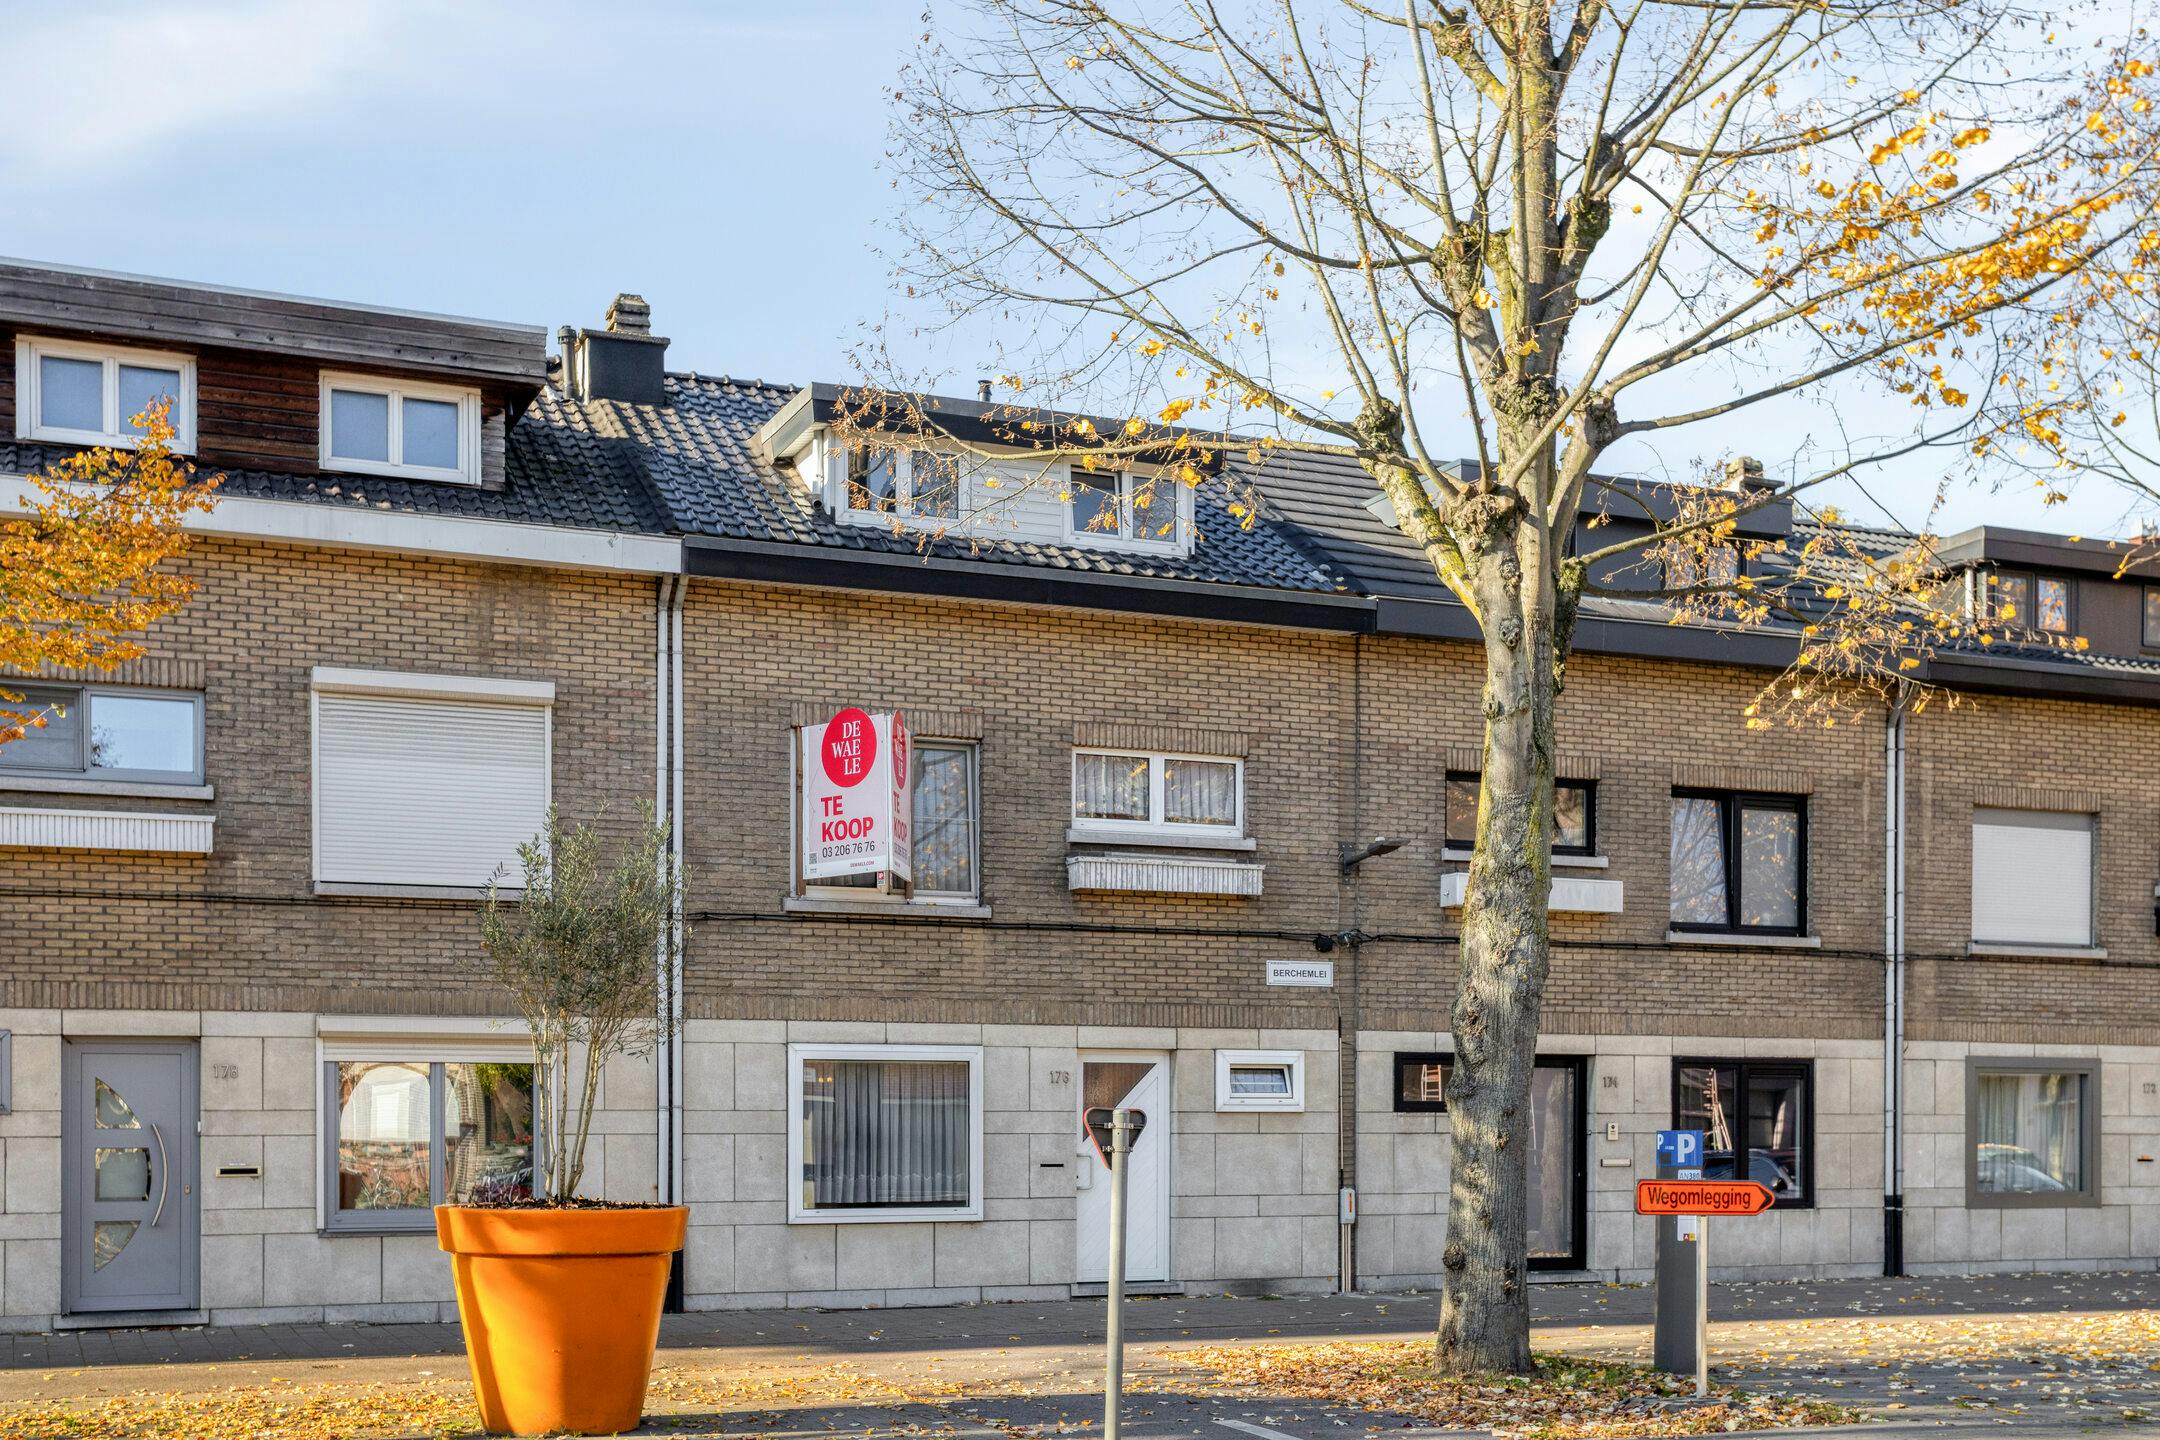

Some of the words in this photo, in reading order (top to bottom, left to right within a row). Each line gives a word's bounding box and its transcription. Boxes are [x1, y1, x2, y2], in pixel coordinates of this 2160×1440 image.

[842, 720, 861, 738] DE
[831, 739, 861, 758] WAE
[843, 757, 861, 776] LE
[820, 795, 843, 817] TE
[893, 790, 900, 814] TE
[821, 816, 874, 843] KOOP
[893, 816, 908, 843] KOOP
[822, 846, 833, 858] 03
[835, 844, 850, 857] 206
[852, 842, 863, 854] 76
[865, 840, 875, 852] 76
[1273, 969, 1327, 978] BERCHEMLEI
[213, 1064, 239, 1079] 178
[1657, 1133, 1664, 1150] P
[1677, 1133, 1696, 1163] P
[1647, 1186, 1752, 1209] Wegomlegging
